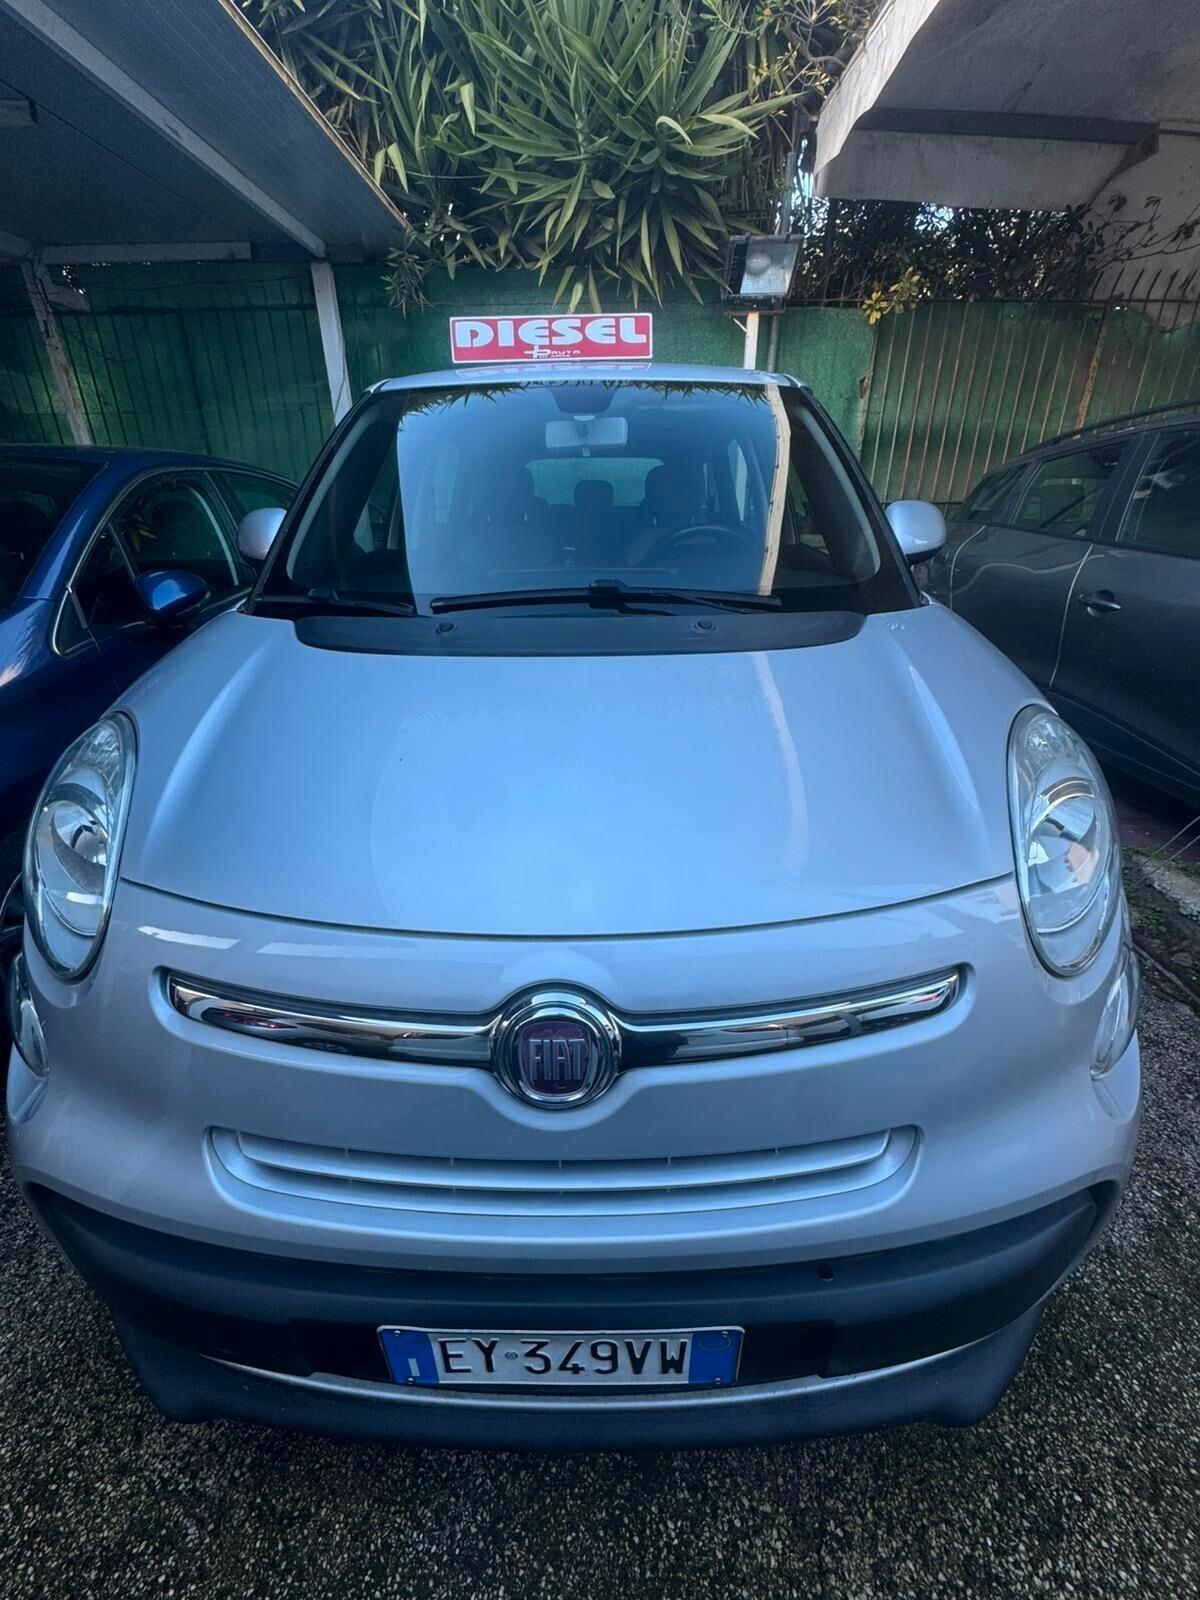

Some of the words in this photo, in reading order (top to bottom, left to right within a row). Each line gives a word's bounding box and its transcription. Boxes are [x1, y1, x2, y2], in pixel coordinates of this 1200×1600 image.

[454, 317, 647, 348] DIESEL
[528, 1038, 585, 1083] FIAT
[437, 1337, 500, 1374] EY
[520, 1338, 689, 1375] 349VW
